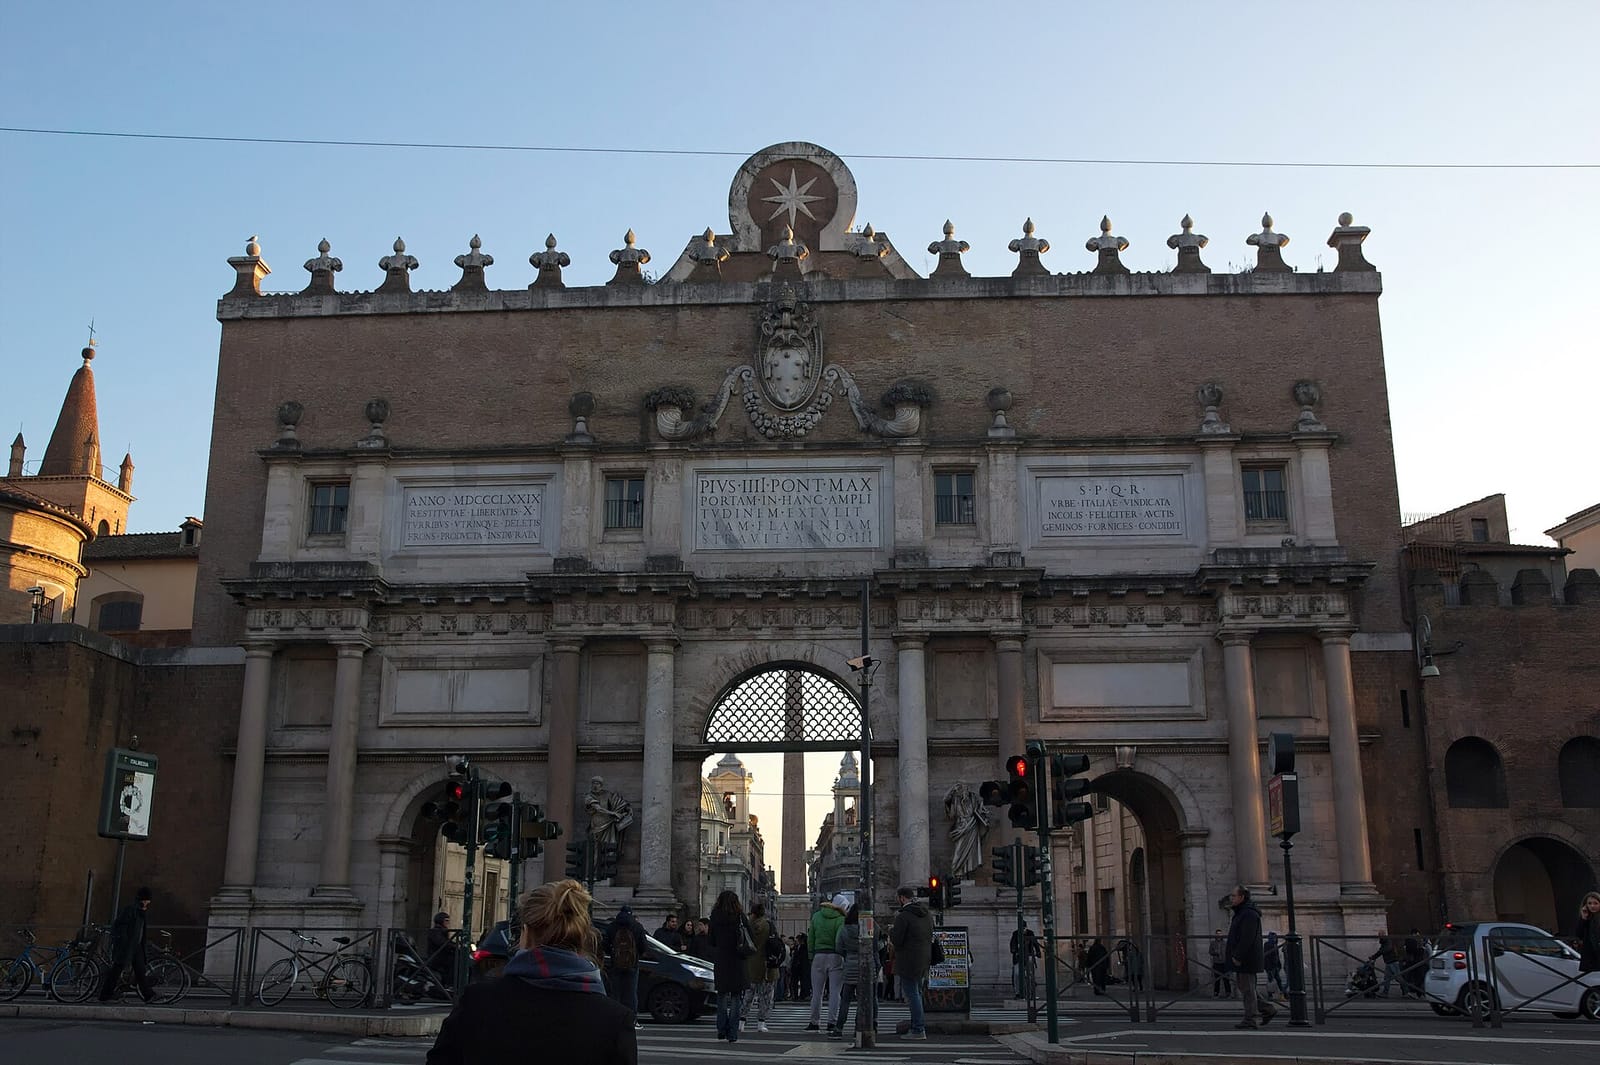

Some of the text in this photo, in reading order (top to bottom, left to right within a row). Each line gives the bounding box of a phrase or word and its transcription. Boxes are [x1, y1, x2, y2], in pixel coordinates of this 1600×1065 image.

[701, 480, 735, 494] PIVS
[771, 479, 824, 493] PONT
[830, 478, 872, 492] MAX
[409, 494, 541, 506] ANNO MDCCCLXXIX
[701, 494, 871, 506] PORTAM IN HANC AMPLI
[1051, 498, 1170, 508] VRBE ITALIAE VINDICATA
[1048, 511, 1083, 520] INCOLIS
[1089, 510, 1137, 519] FELICITER
[701, 521, 748, 531] VIAM
[1042, 522, 1181, 532] GEMINOS FORNICES CONDIDIT
